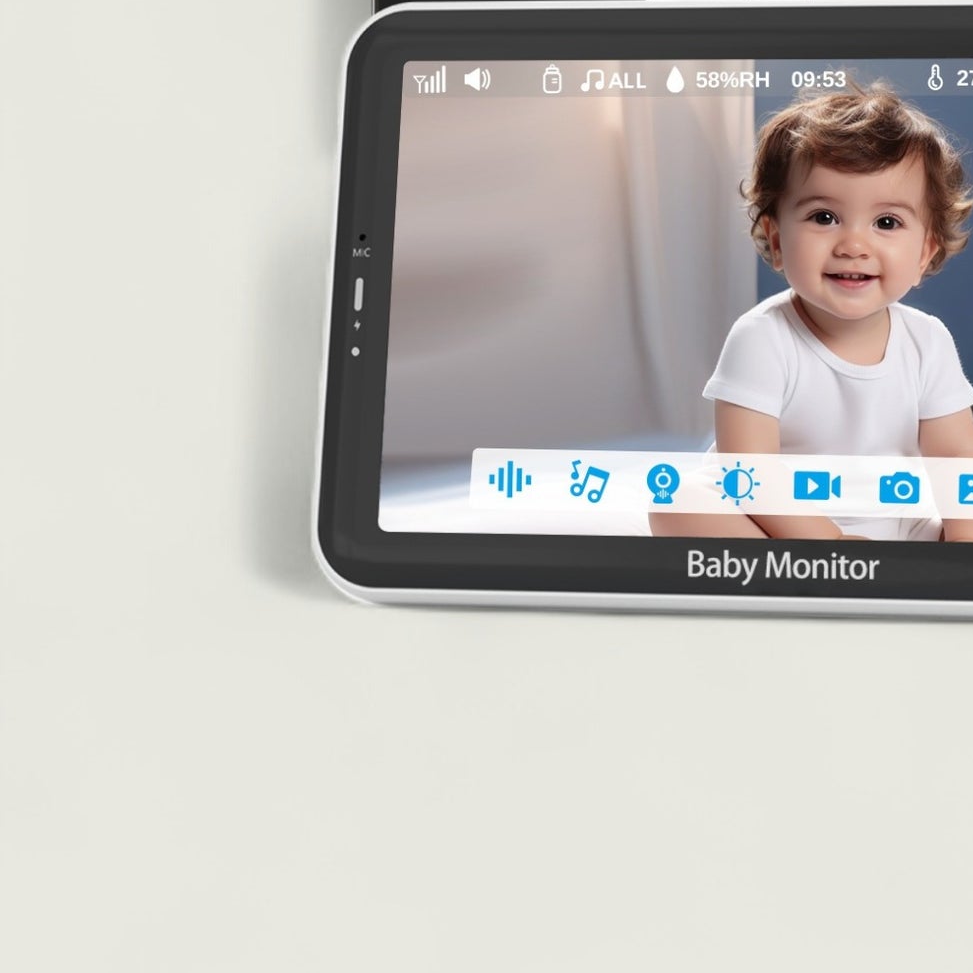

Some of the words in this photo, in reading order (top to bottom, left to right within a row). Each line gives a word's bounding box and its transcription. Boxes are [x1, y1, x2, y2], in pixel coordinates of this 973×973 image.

[608, 72, 647, 90] ALL
[695, 71, 771, 89] 58%RH
[790, 70, 847, 89] 09:53
[352, 247, 372, 258] MIC
[686, 549, 758, 586] Baby
[764, 550, 881, 582] Monitor
